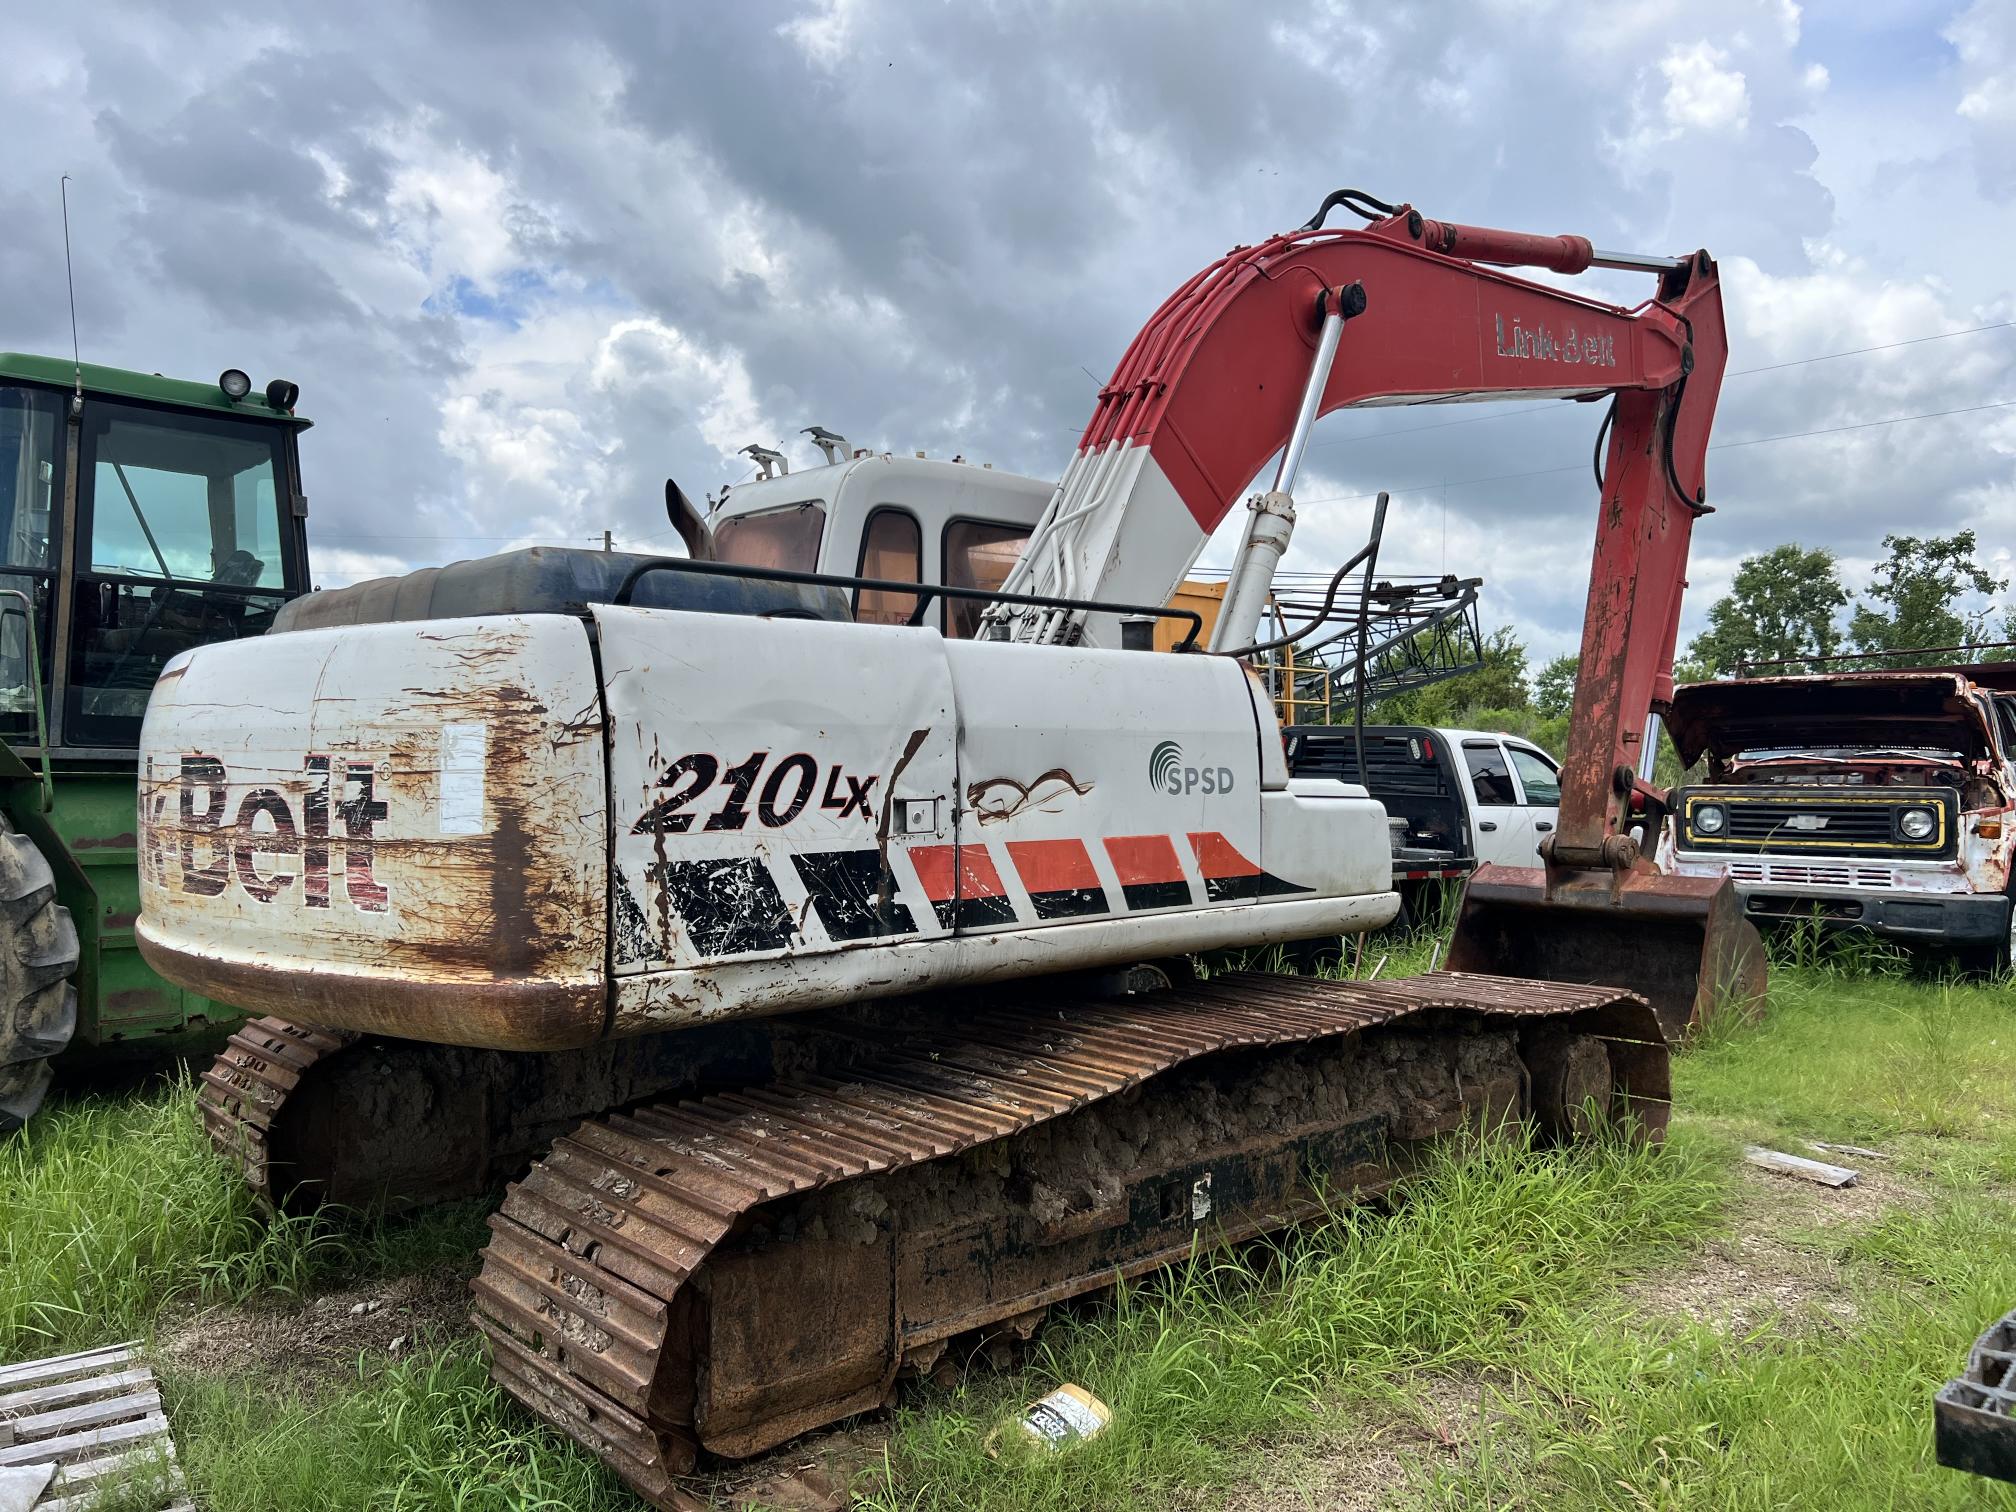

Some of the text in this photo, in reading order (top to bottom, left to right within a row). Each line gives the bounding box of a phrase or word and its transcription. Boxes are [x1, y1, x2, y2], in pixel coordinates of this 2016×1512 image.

[629, 751, 880, 836] 210 LX
[1167, 767, 1234, 796] SPSD
